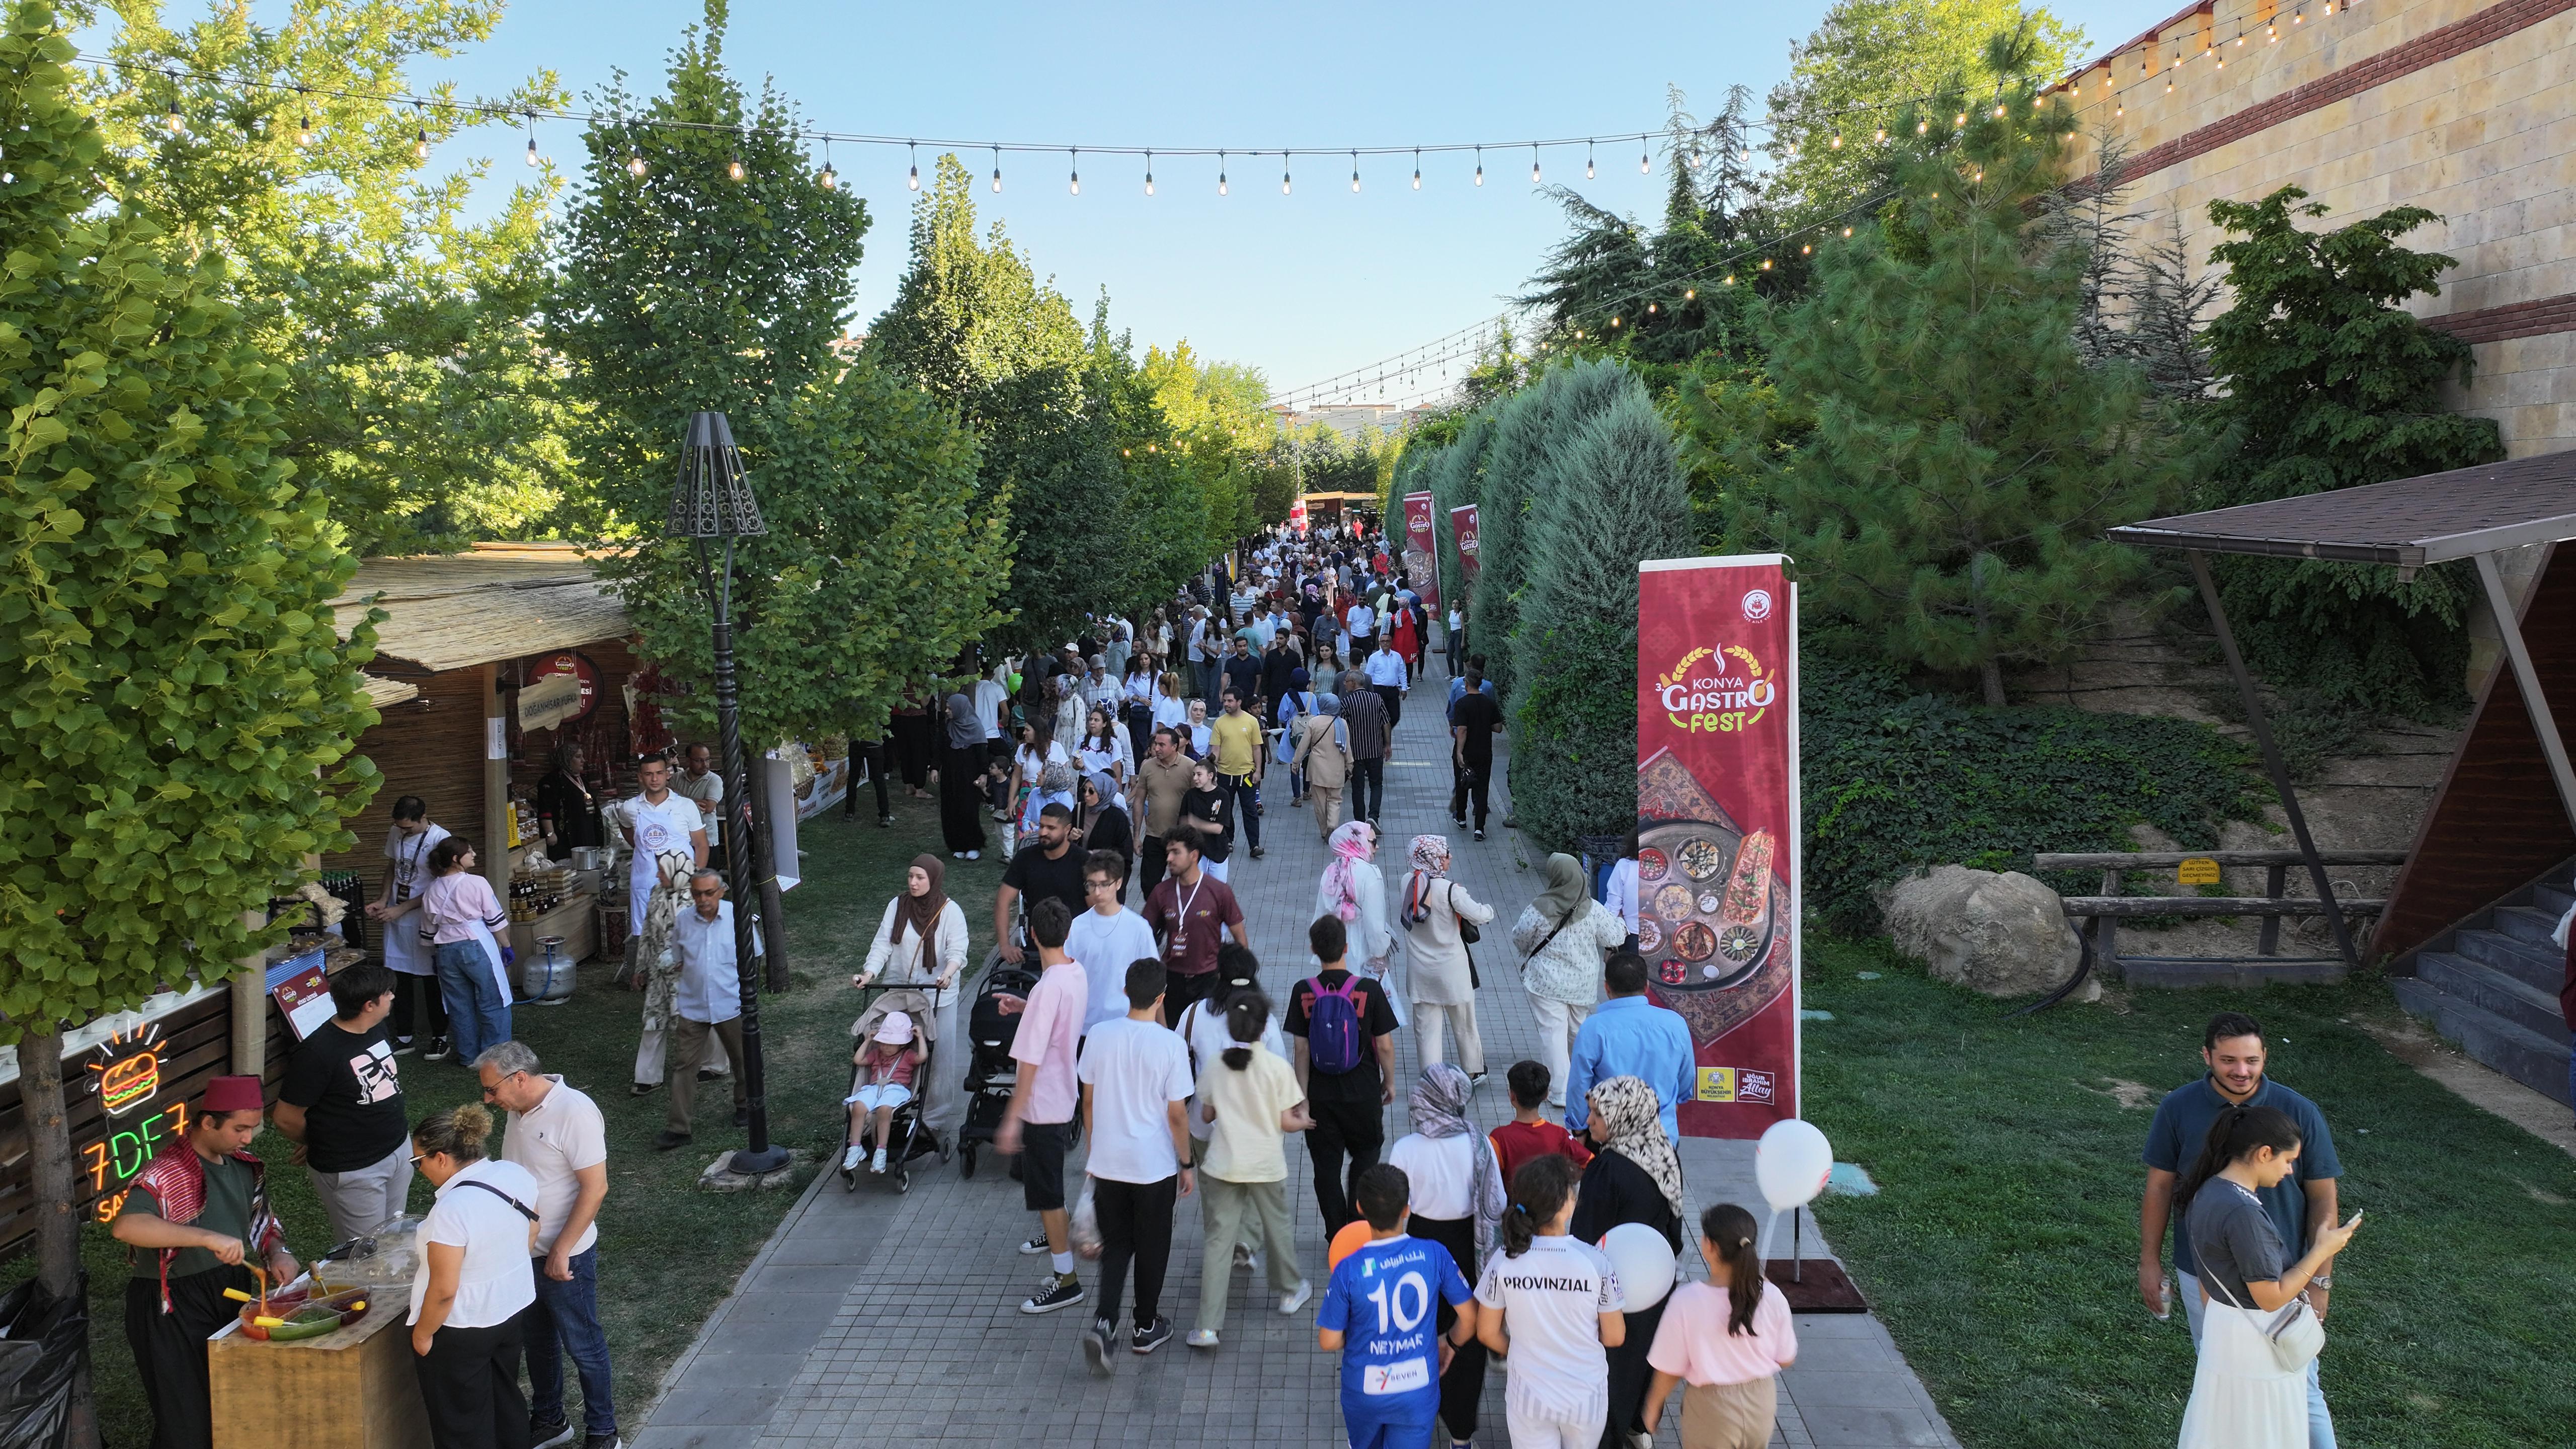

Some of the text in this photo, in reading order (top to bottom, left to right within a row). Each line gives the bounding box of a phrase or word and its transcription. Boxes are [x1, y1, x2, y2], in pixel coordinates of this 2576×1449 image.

[1693, 677, 1744, 690] KONYA
[1655, 679, 1775, 712] 3. GASTRO
[498, 741, 502, 749] 6
[1740, 1083, 1771, 1098] Altay
[1503, 1276, 1592, 1293] PROVINZIAL
[1366, 1270, 1428, 1335] 10
